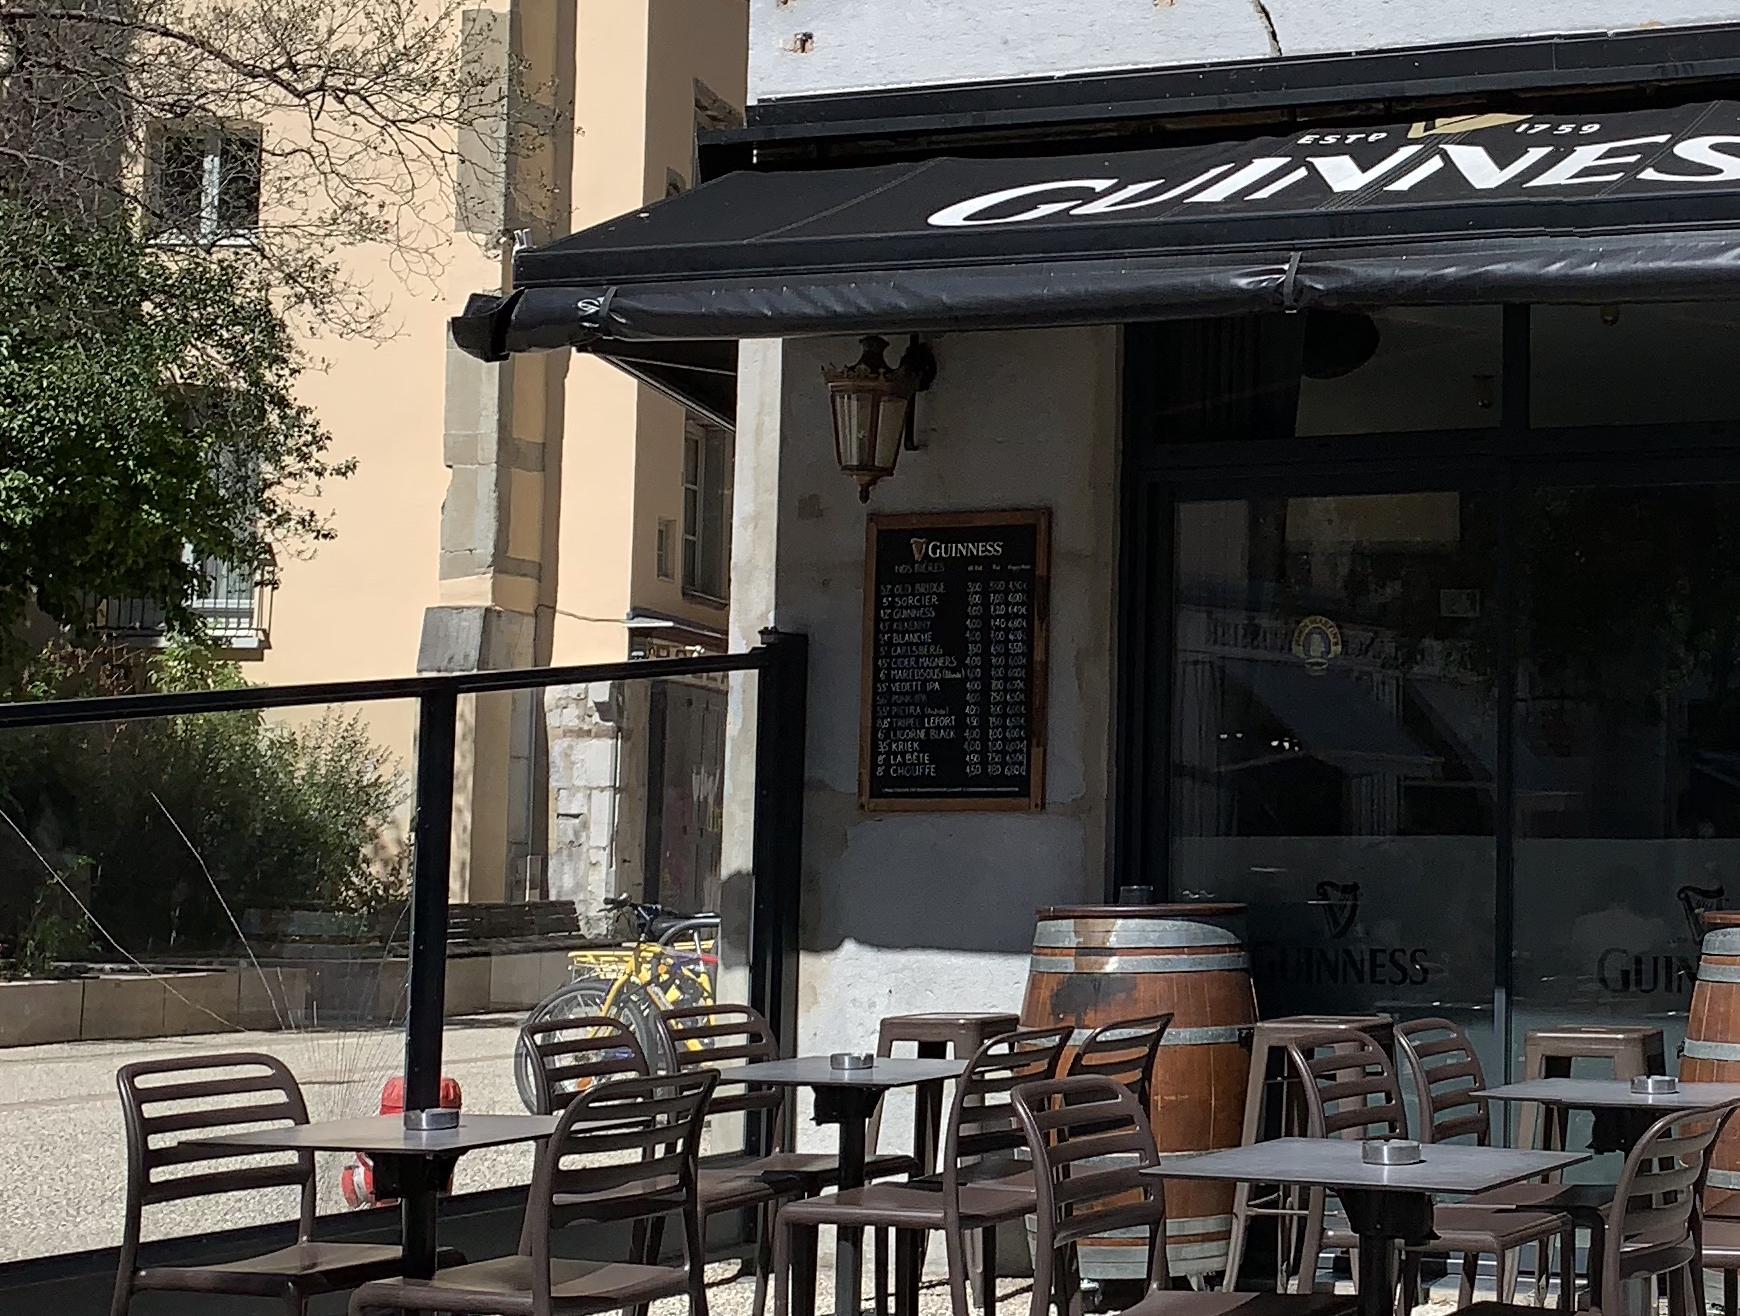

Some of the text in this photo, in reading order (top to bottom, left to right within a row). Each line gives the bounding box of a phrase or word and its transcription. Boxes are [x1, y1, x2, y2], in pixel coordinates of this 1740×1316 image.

[1515, 123, 1601, 135] 1759
[928, 541, 1004, 558] GUINNESS
[894, 595, 939, 606] SORCIER
[892, 631, 933, 643] BLANCHE
[891, 644, 943, 656] CARLSBERG
[890, 668, 942, 680] MAREDSOUS
[890, 681, 922, 692] VEDETT
[926, 681, 941, 692] IPA
[924, 715, 956, 727] LEFORT
[929, 728, 956, 740] BLACK
[891, 740, 920, 752] KRIEK
[890, 754, 903, 764] LA
[905, 751, 930, 764] BÊTE
[890, 765, 937, 776] CHOUFFE
